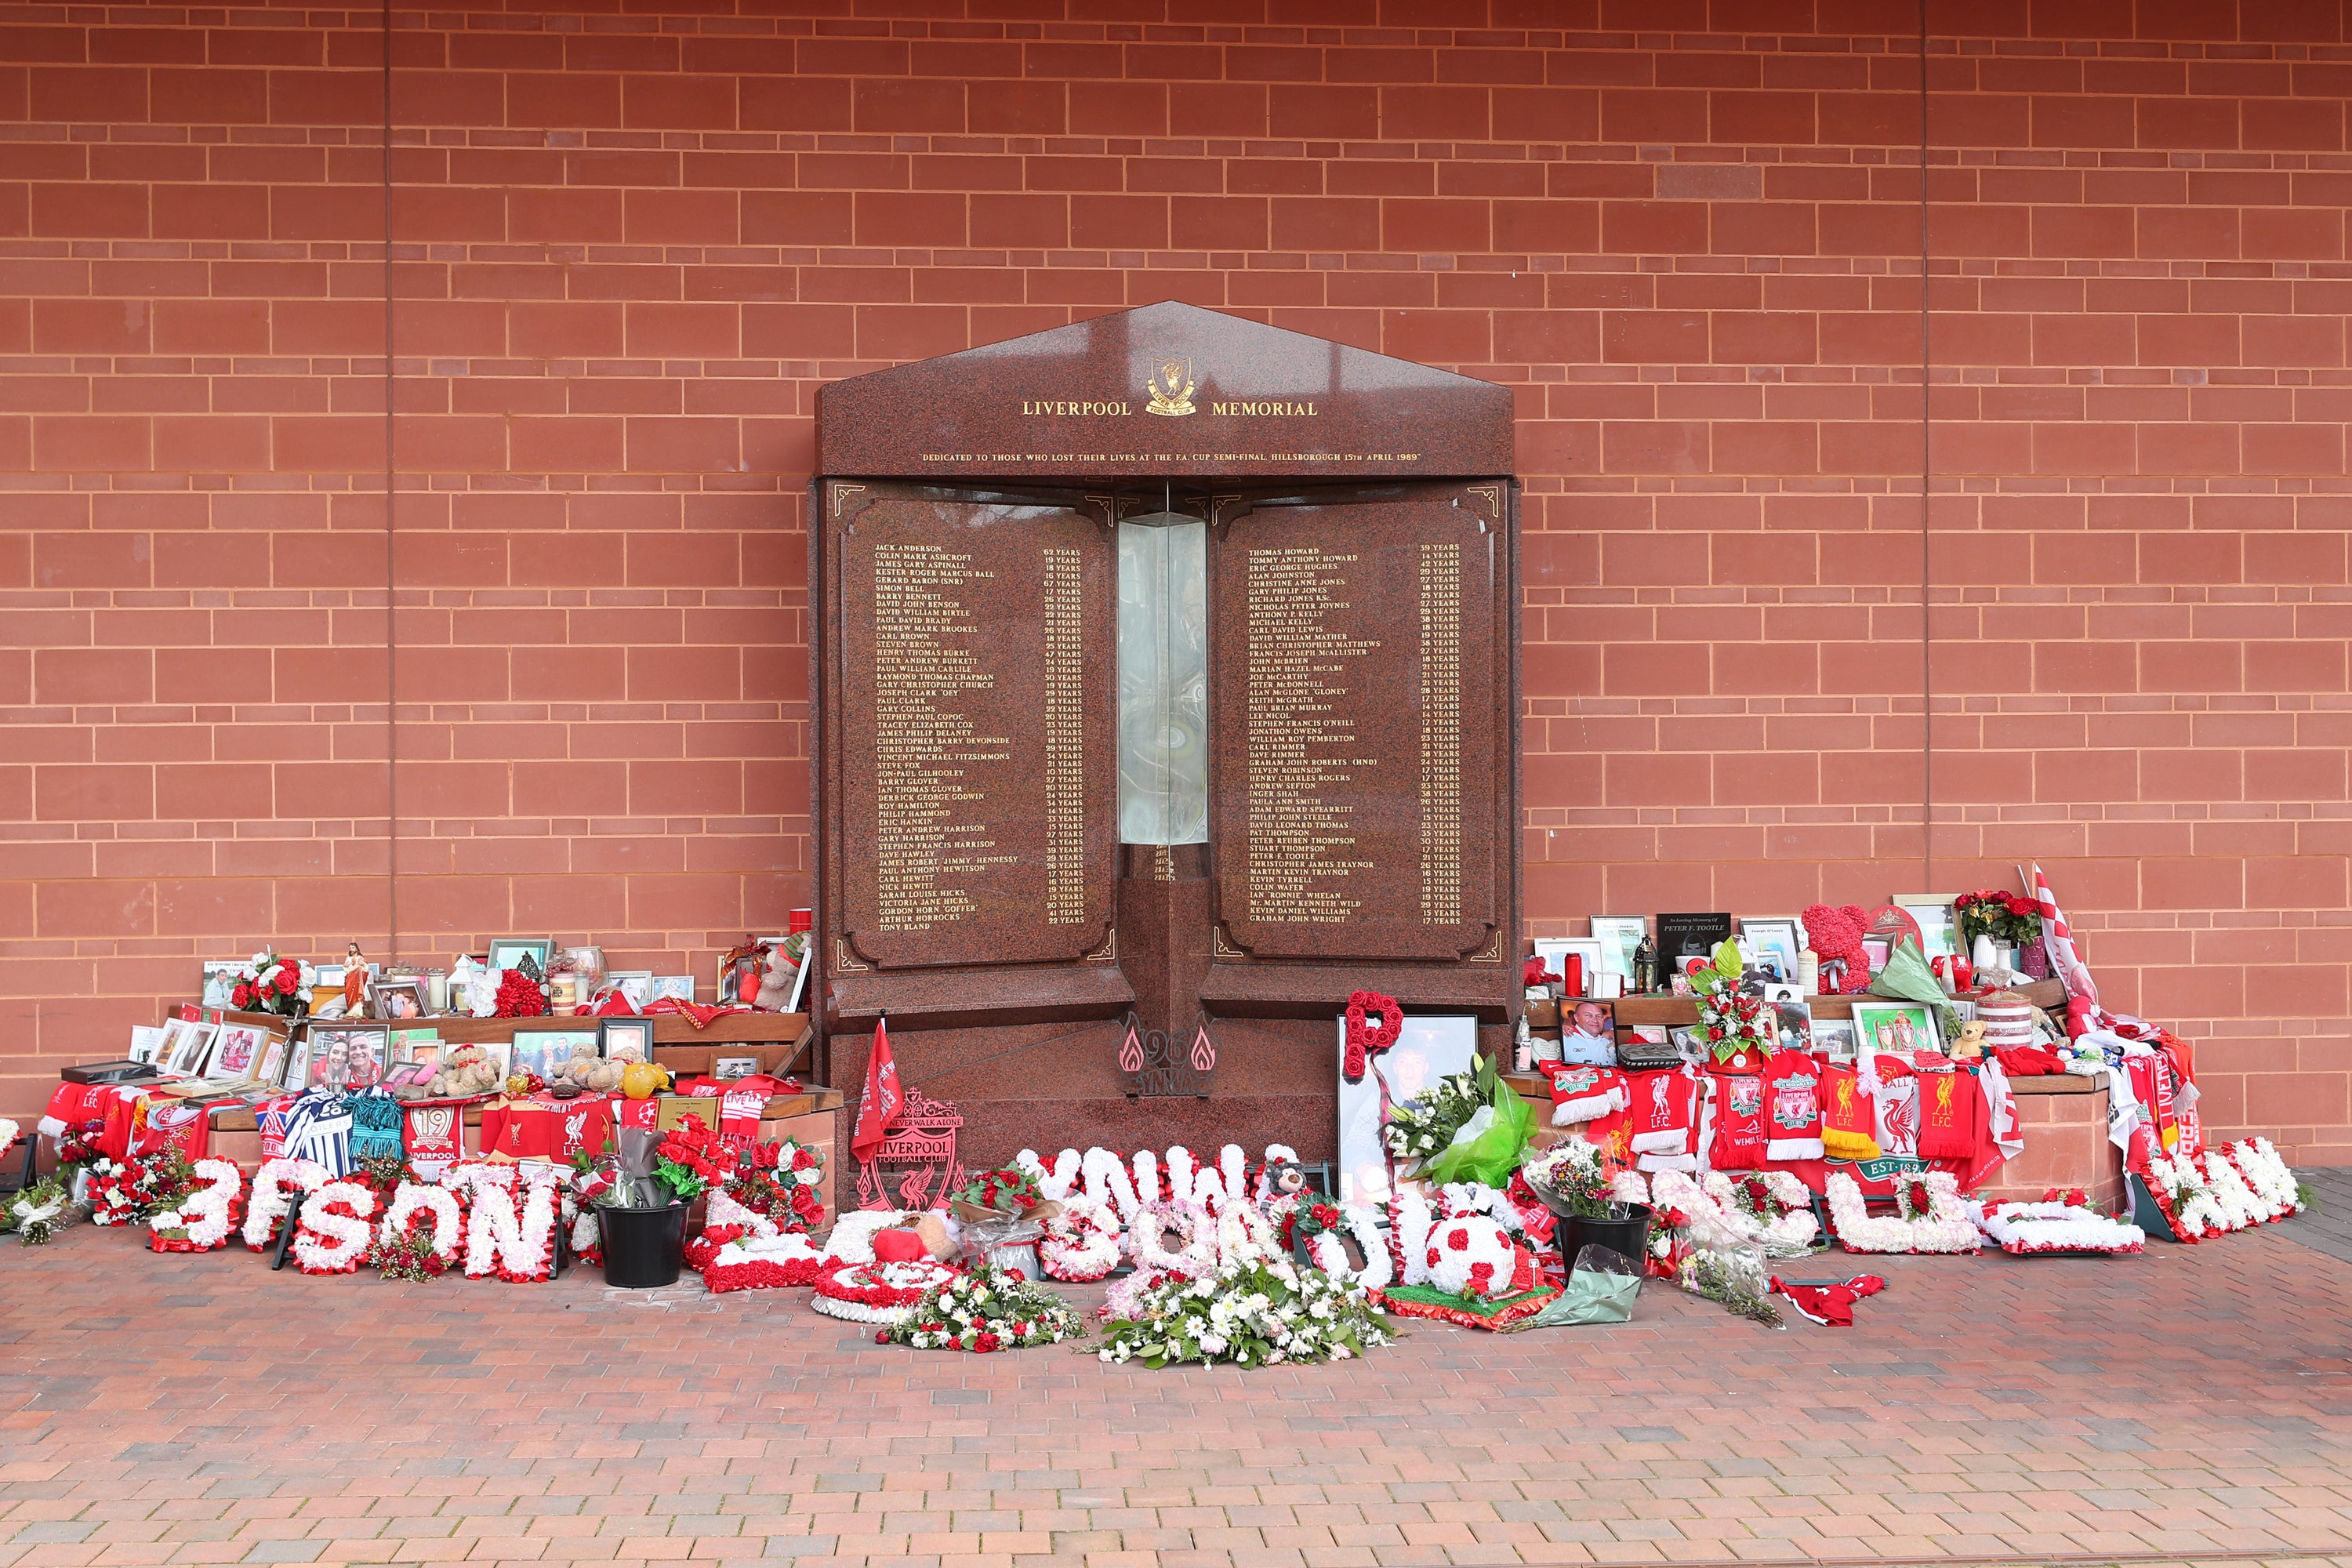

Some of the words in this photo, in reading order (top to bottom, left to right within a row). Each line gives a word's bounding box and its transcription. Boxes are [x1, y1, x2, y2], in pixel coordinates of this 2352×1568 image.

[1152, 391, 1170, 407] LIVER
[1173, 394, 1189, 407] POOL
[1022, 401, 1132, 416] LIVERPOOL
[1212, 401, 1319, 416] MEMORIAL
[976, 453, 988, 462] TO
[992, 453, 1022, 462] THOSE
[1026, 453, 1048, 462] WHO
[1052, 453, 1074, 462] LOST
[1078, 453, 1105, 462] THEIR
[1110, 453, 1136, 462] LIVES
[1139, 453, 1151, 462] AT
[1154, 453, 1172, 462] THE
[1192, 453, 1210, 462] CUP
[1271, 453, 1341, 462] HILLSBOROUGH
[1367, 453, 1393, 462] APRIL
[1344, 989, 1404, 1080] P
[1144, 1029, 1192, 1065] 96
[419, 1109, 447, 1135] 19
[1651, 1117, 1671, 1129] L.F.C.
[1932, 1116, 1953, 1128] L.F.C.
[409, 1151, 457, 1160] LIVERPOOL
[877, 1141, 949, 1155] LIVERPOOL
